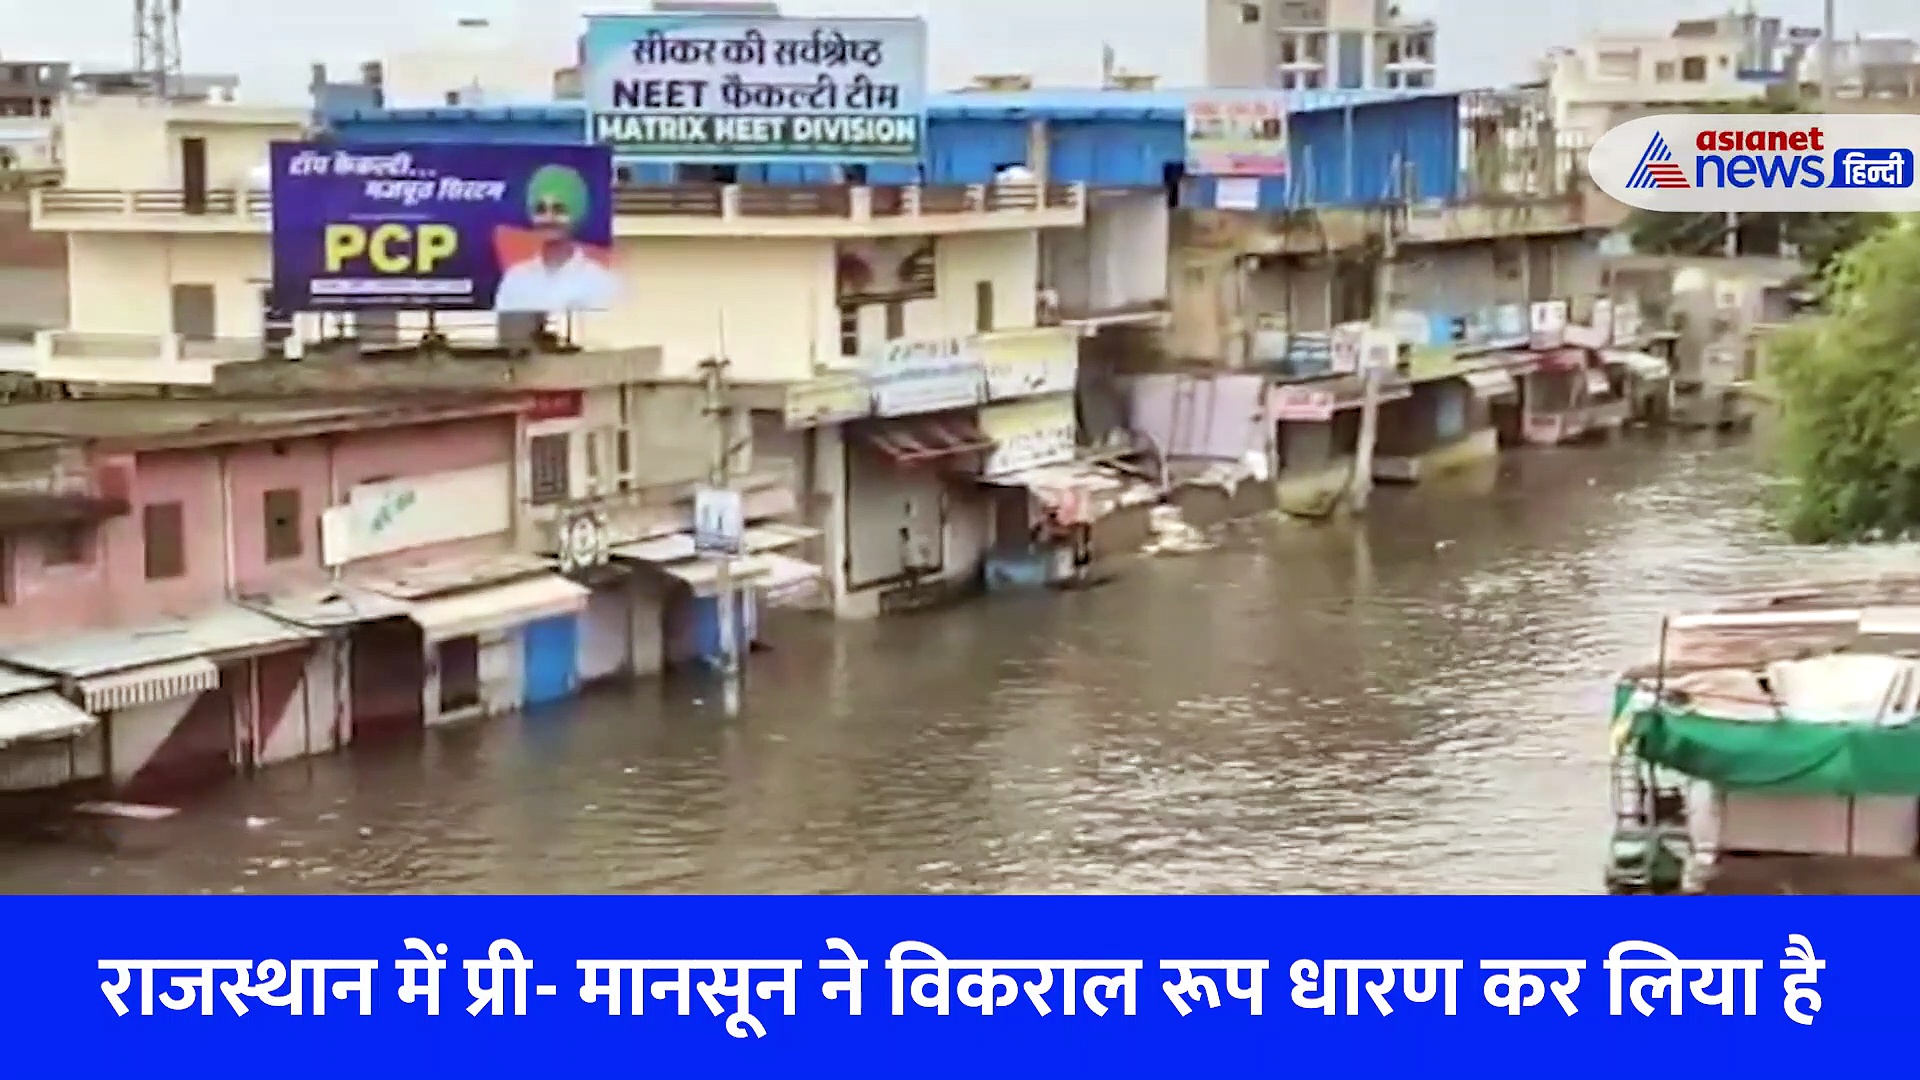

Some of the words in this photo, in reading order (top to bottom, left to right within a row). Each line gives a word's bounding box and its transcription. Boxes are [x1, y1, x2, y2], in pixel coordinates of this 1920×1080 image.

[632, 28, 716, 64] सीकर
[721, 28, 766, 64] की
[774, 28, 884, 67] सर्वश्रेष्ठ
[612, 80, 708, 107] NEET
[721, 73, 838, 108] फैकल्टी
[845, 73, 899, 108] टीम
[598, 116, 707, 142] MATRIX
[793, 116, 916, 142] DIVISION
[325, 223, 458, 273] PCP
